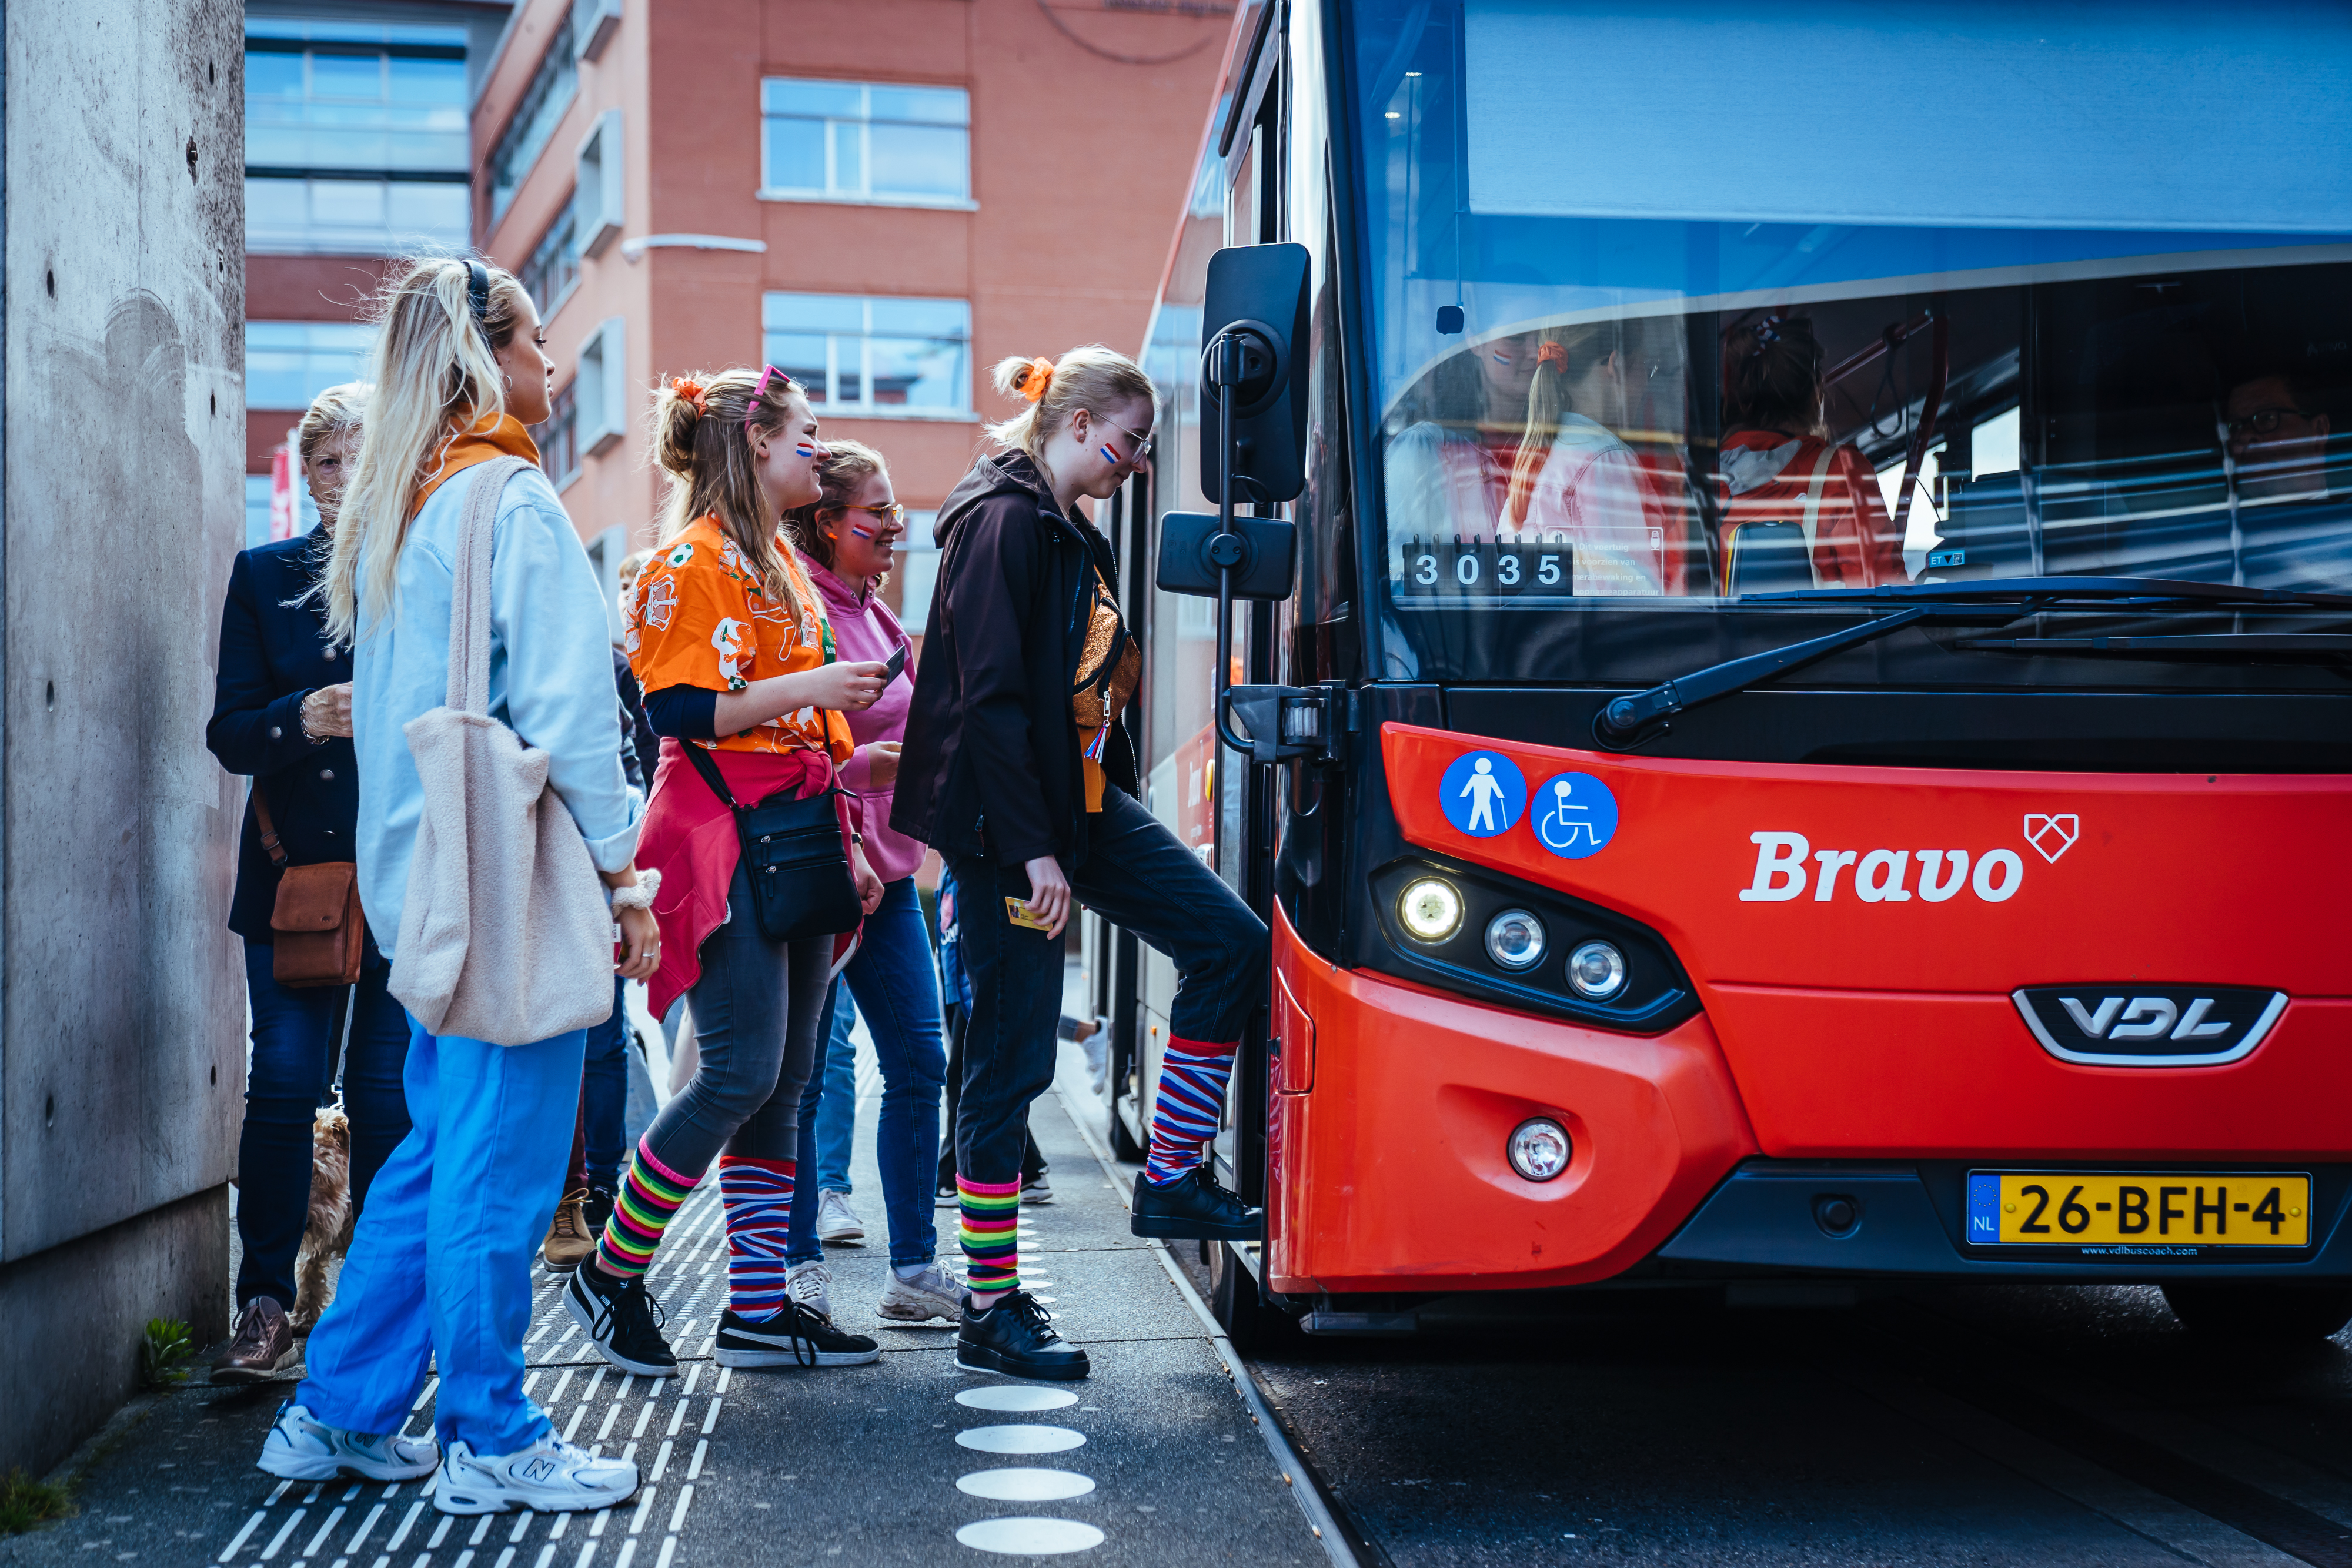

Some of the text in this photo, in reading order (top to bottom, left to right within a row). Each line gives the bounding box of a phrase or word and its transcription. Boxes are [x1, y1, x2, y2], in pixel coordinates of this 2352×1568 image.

[1594, 543, 1629, 552] voertuig
[1739, 831, 2023, 902] Bravo
[2058, 997, 2231, 1041] VDL
[2019, 1185, 2286, 1235] 26-BFH-4
[1974, 1216, 1995, 1231] NL
[2081, 1246, 2197, 1256] www.vdlbuscoach.com
[600, 1294, 611, 1306] PUM
[523, 1458, 556, 1482] N
